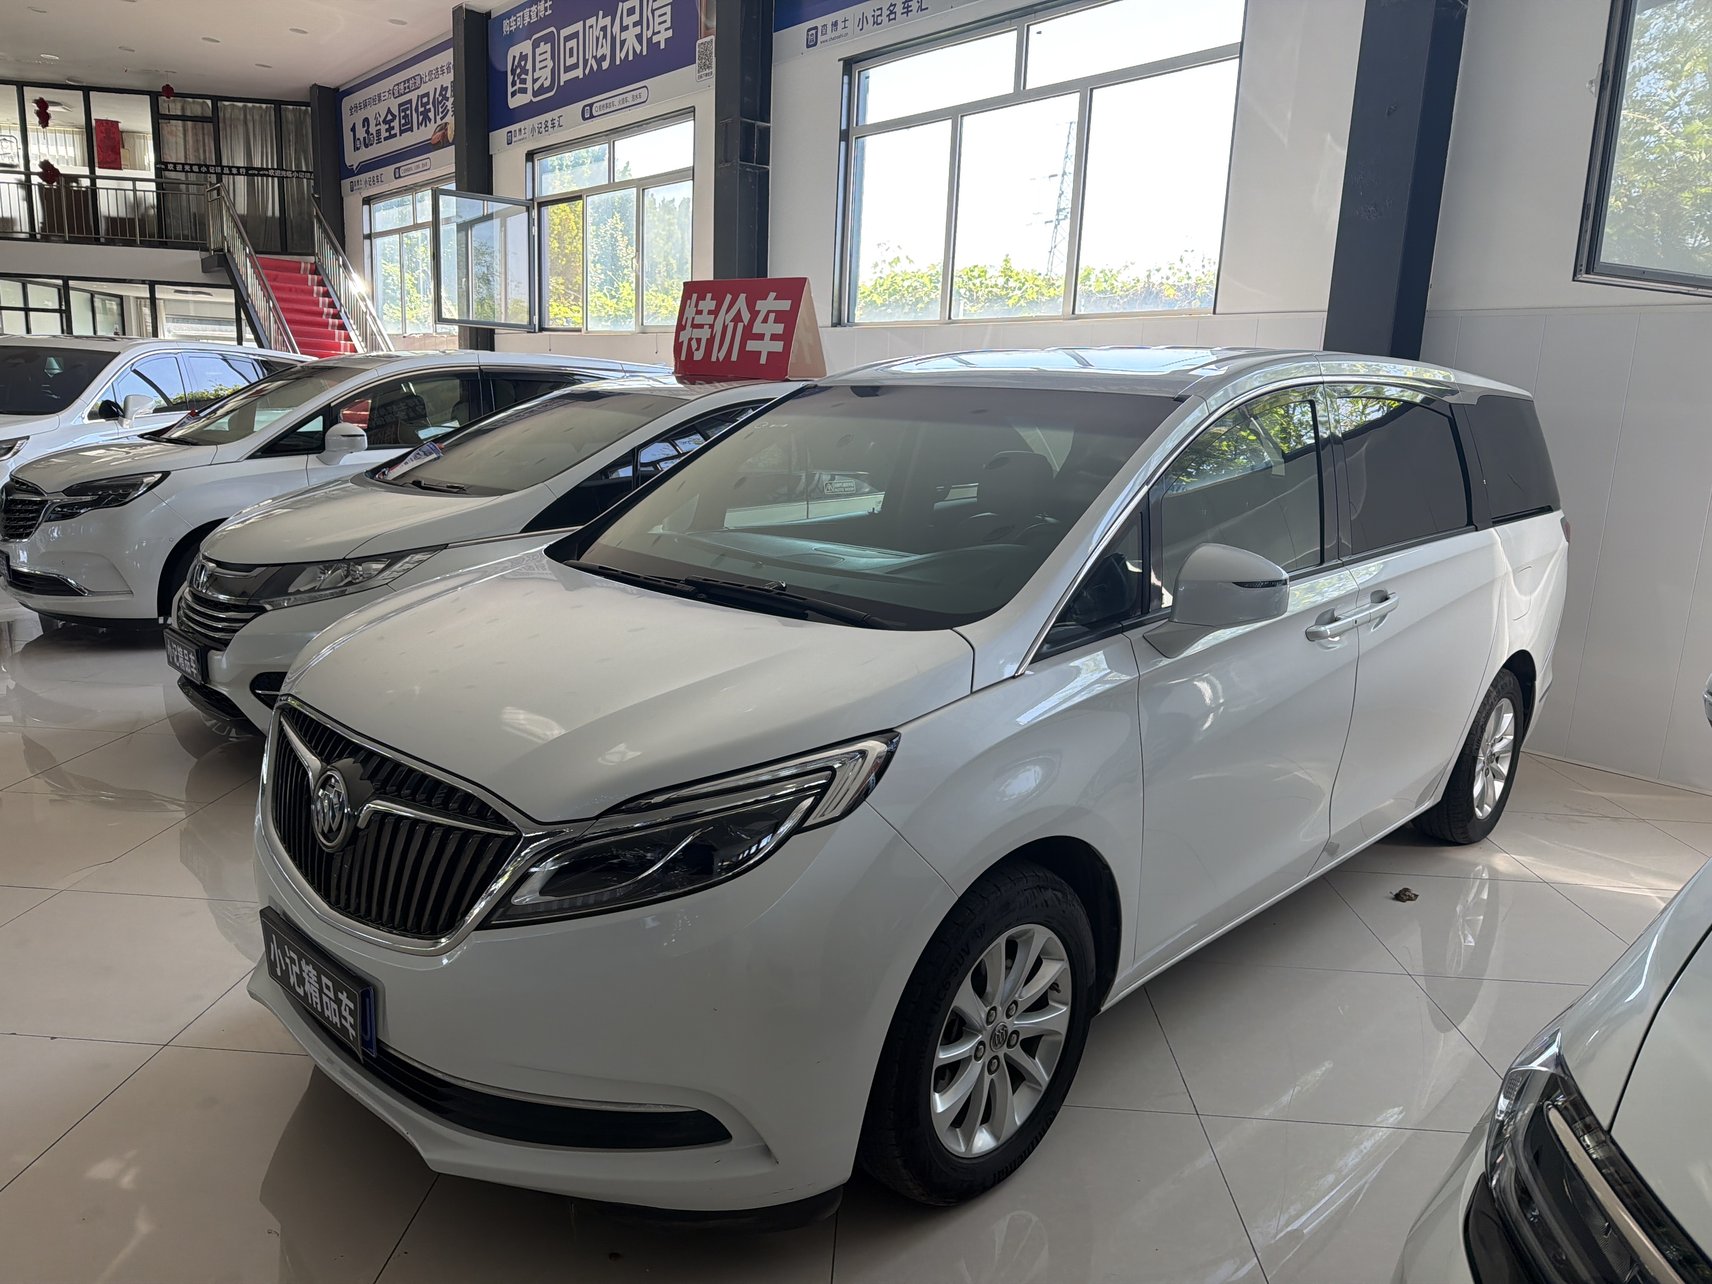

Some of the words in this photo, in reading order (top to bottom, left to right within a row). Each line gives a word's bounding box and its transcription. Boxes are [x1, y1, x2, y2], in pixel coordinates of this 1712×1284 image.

[502, 0, 553, 36] 购车可享查博士
[857, 0, 929, 32] 小记名车汇
[510, 0, 674, 99] 终身回购保障
[530, 115, 564, 137] 小记名车汇
[679, 291, 792, 365] 特价车
[167, 639, 197, 677] 小记精品车
[270, 934, 356, 1041] 小记精品车
